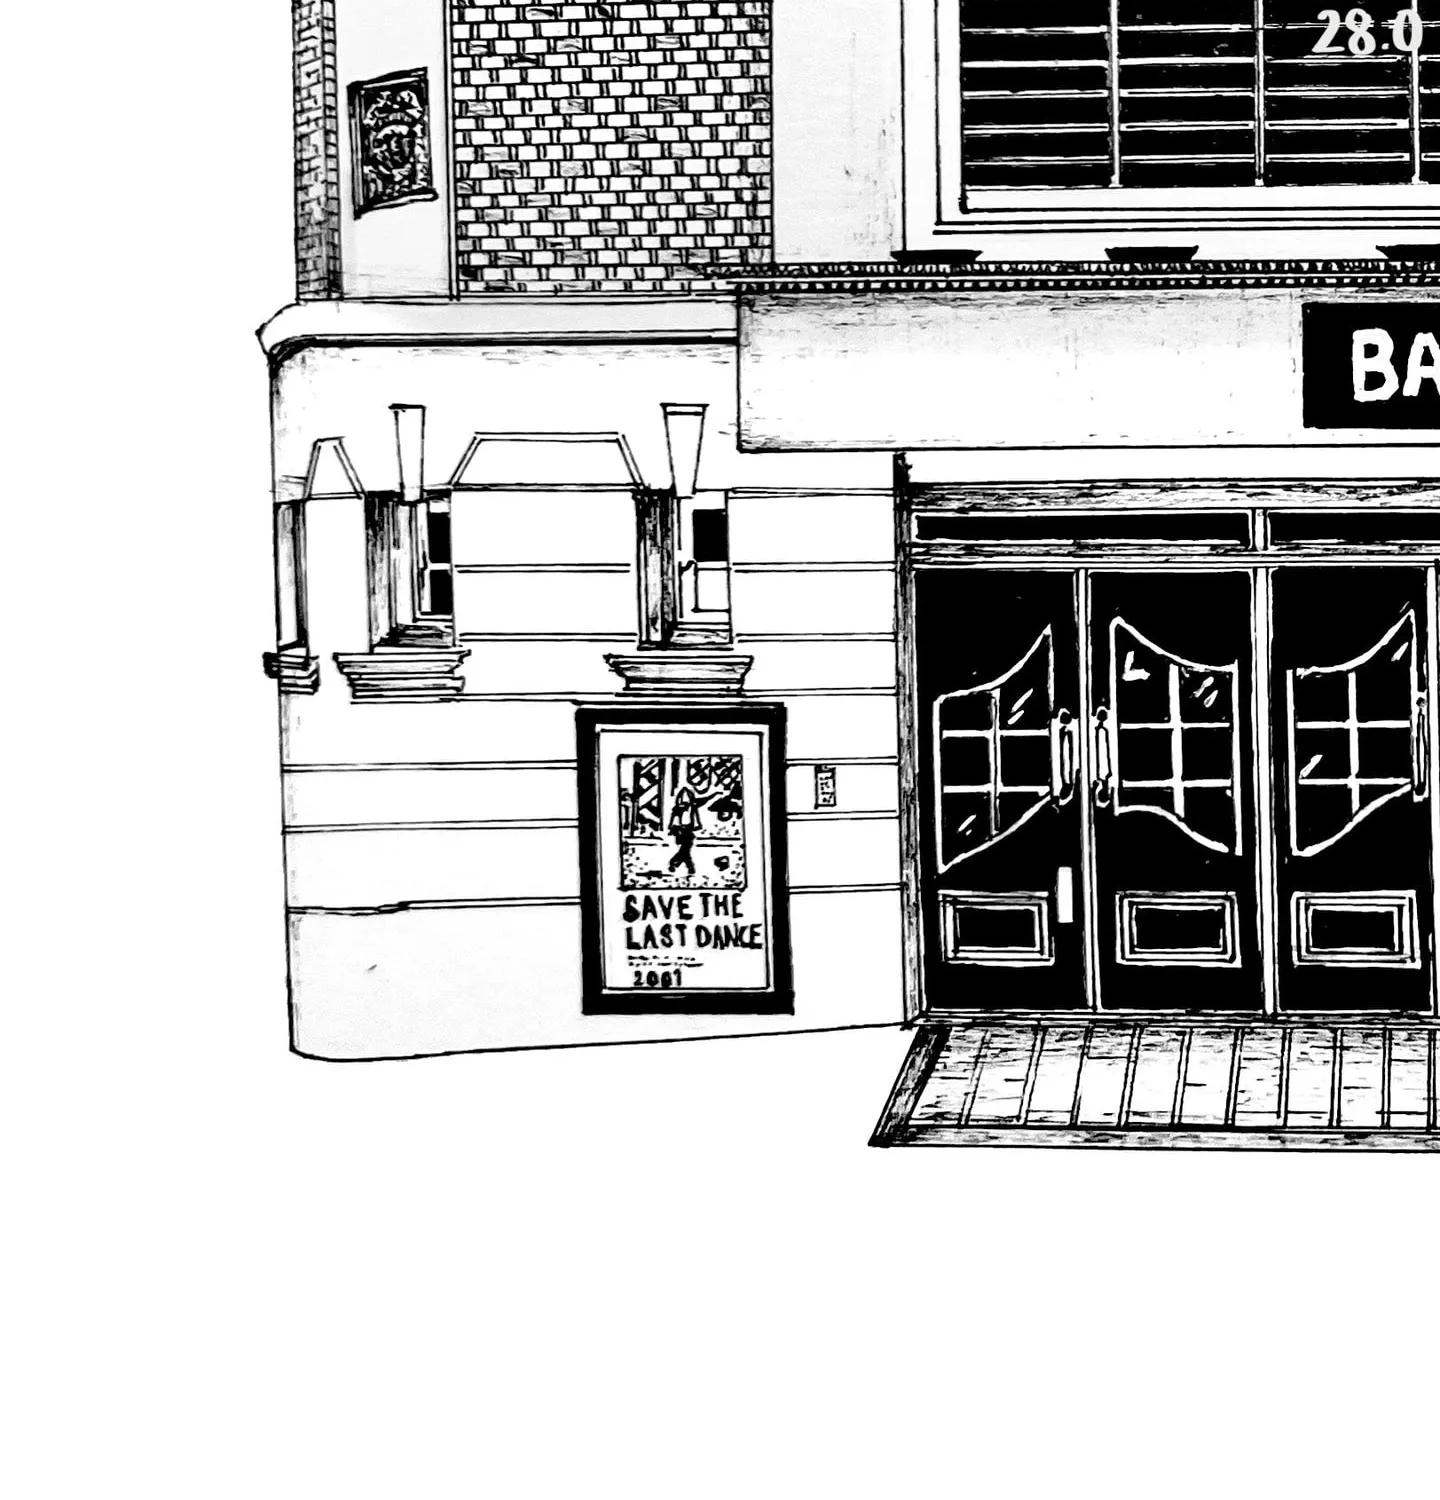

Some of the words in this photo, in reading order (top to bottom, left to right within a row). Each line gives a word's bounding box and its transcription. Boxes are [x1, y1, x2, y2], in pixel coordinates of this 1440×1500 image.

[622, 894, 694, 923] SAVE
[699, 892, 744, 918] THE
[626, 923, 688, 950] LAST
[695, 922, 763, 950] DANCE
[633, 968, 682, 987] 2001
